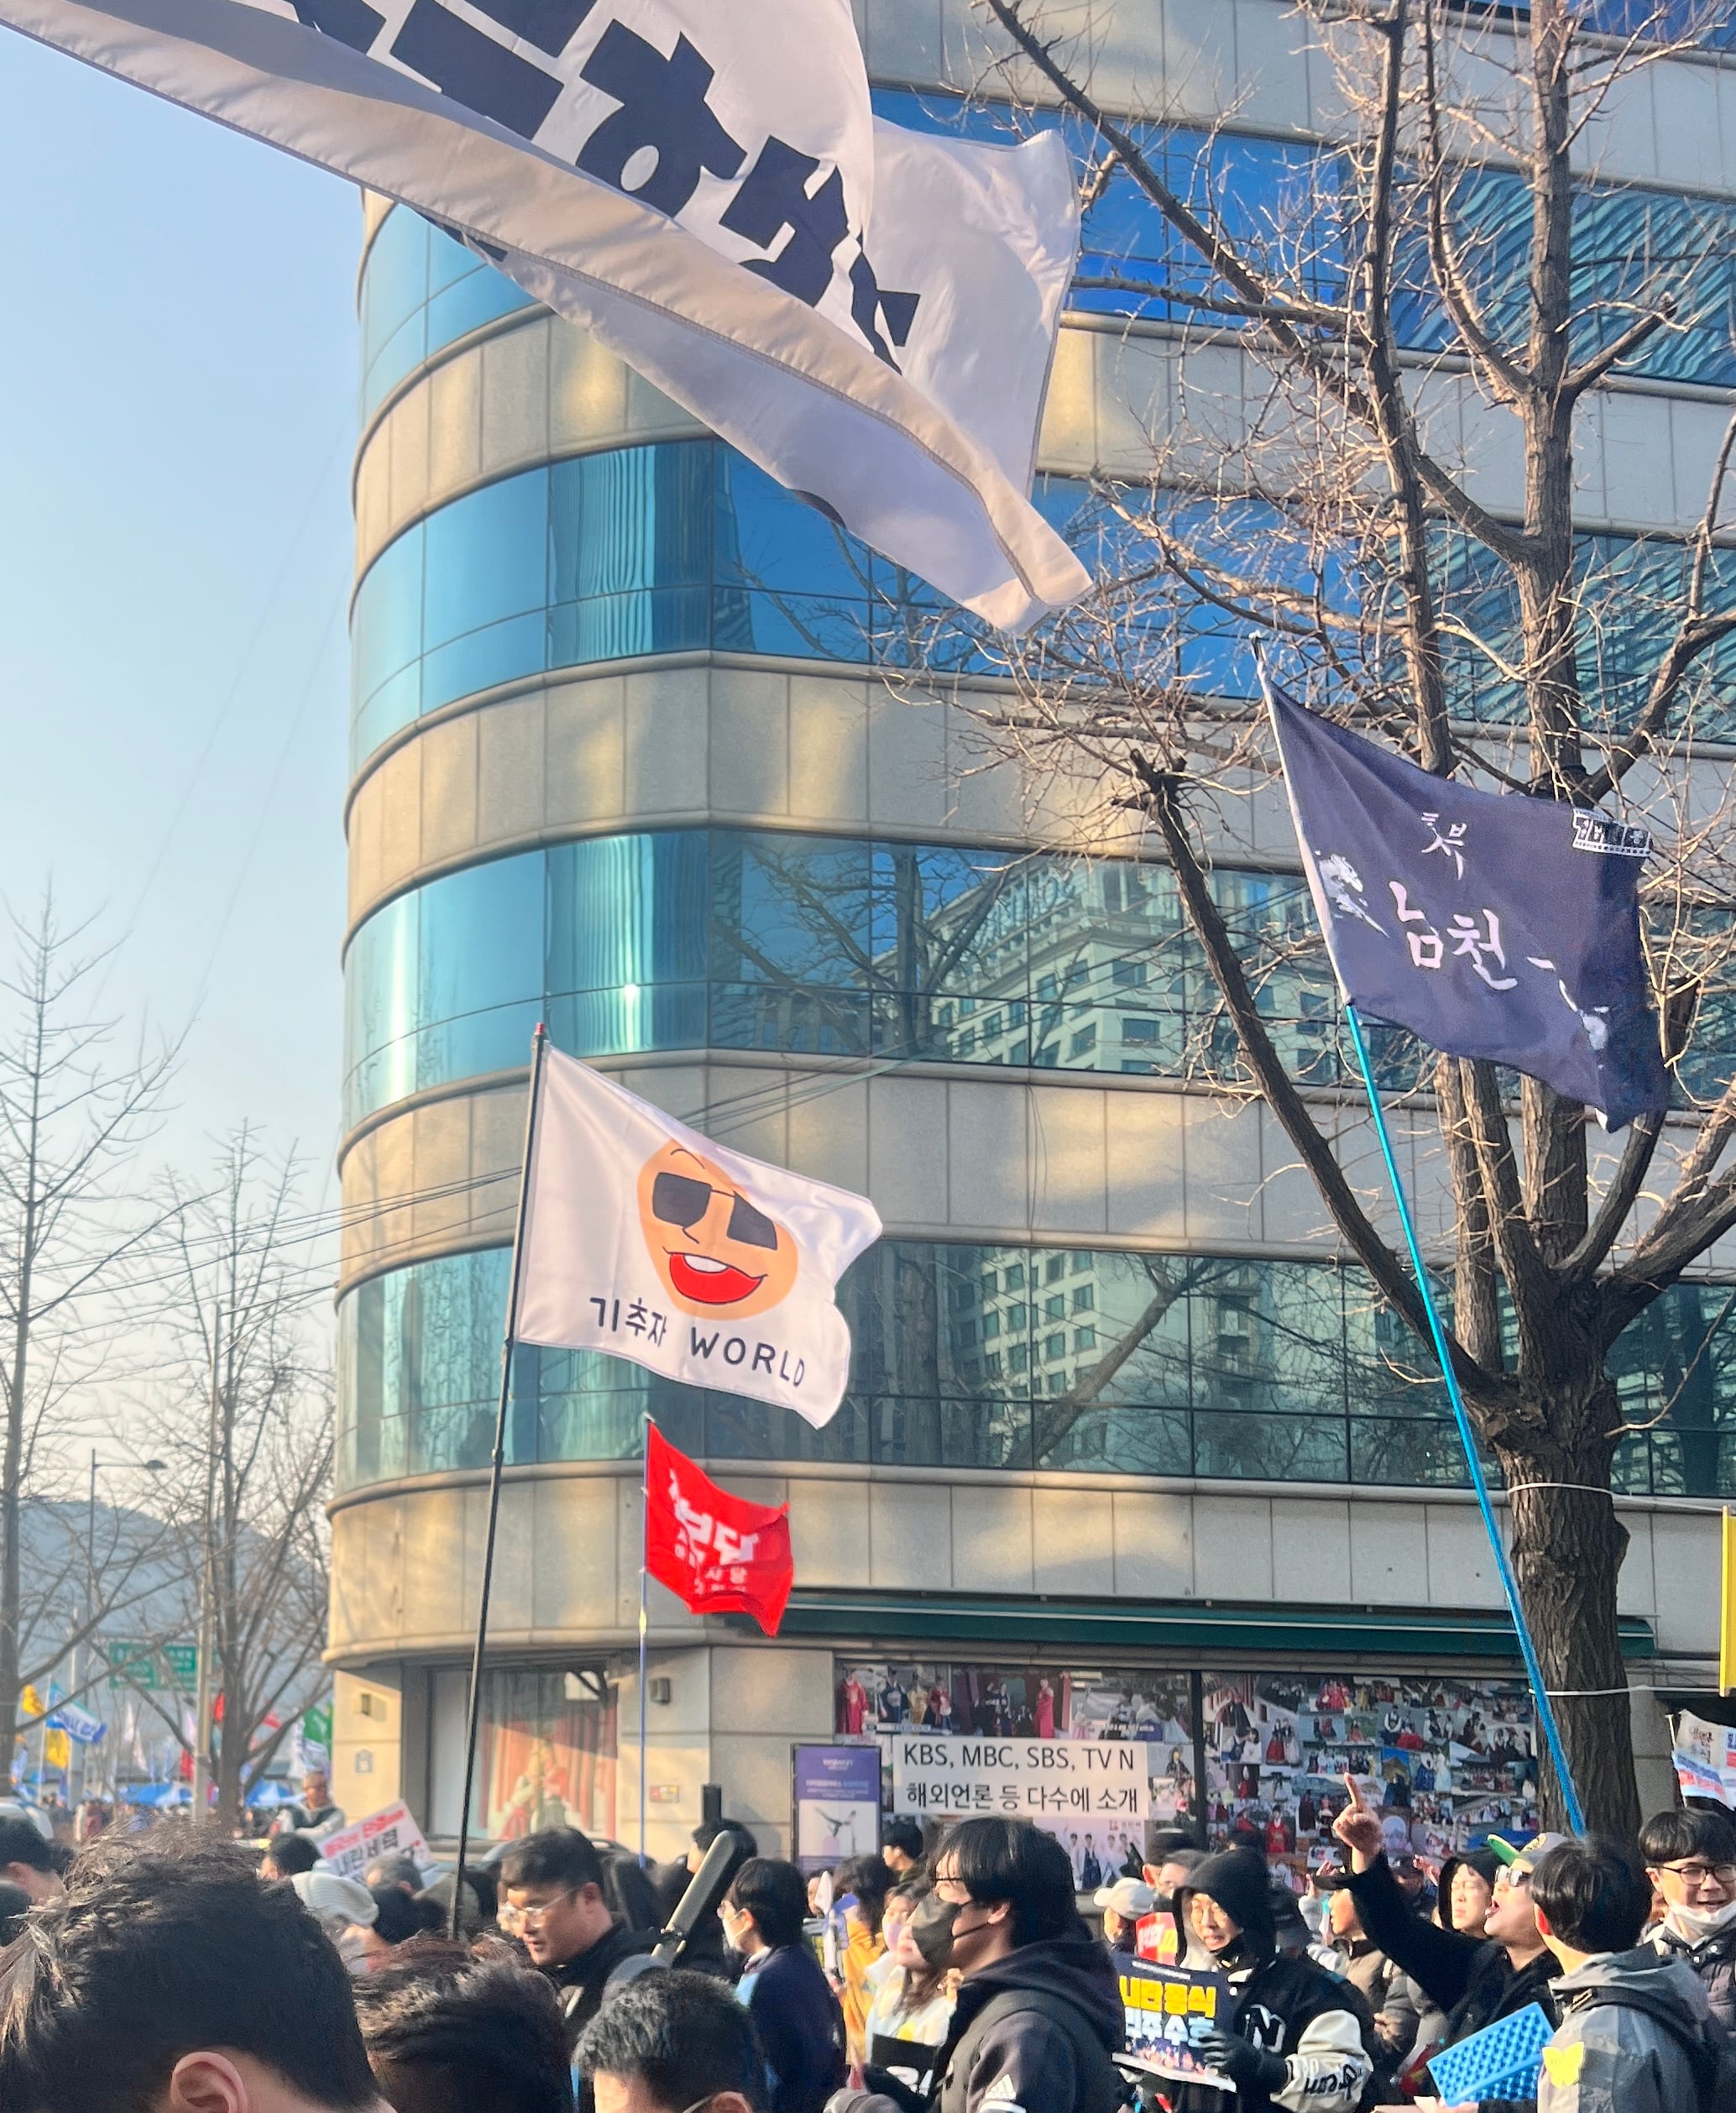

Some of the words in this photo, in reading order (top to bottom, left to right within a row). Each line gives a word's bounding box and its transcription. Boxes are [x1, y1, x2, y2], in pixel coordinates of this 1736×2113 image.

[589, 1297, 667, 1347] 기추자
[690, 1326, 806, 1388] WORLD
[904, 1743, 954, 1769] KBS,
[962, 1745, 1020, 1770] MBC,
[1027, 1746, 1076, 1772] SBS,
[906, 1782, 994, 1810] 해외언론
[999, 1785, 1021, 1810] 등
[1027, 1786, 1090, 1812] 다수에
[1096, 1787, 1138, 1813] 소개
